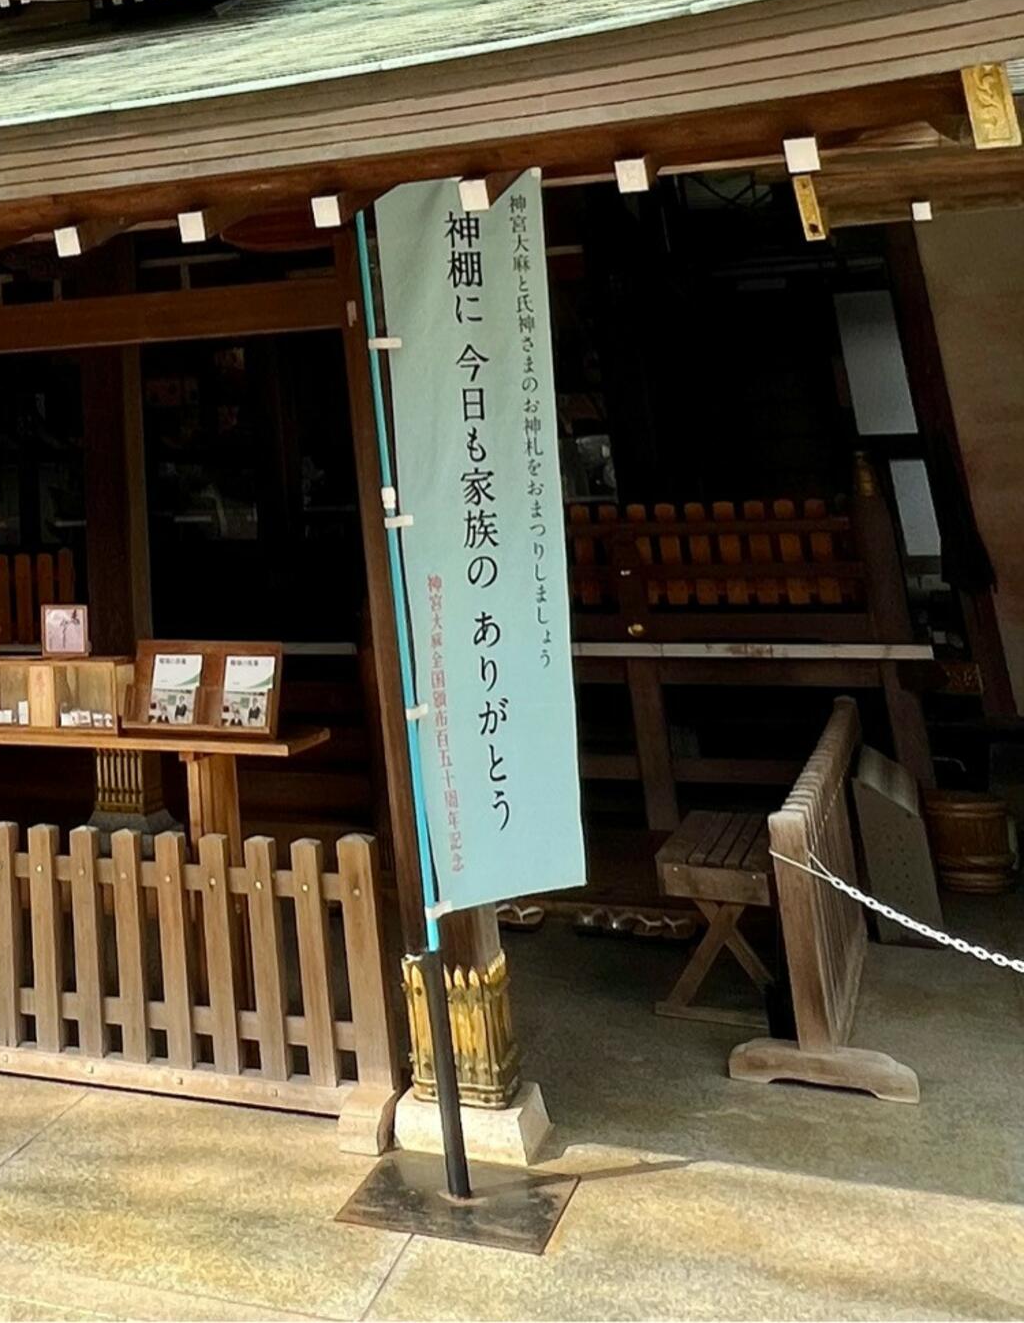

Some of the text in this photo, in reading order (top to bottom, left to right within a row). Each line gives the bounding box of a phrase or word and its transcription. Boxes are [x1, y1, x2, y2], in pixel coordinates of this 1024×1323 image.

[444, 211, 512, 831] 神棚に 今日も家族の ありがとう
[509, 194, 552, 669] 神宮大麻と氏神さまのお神札をおまつりしましょう
